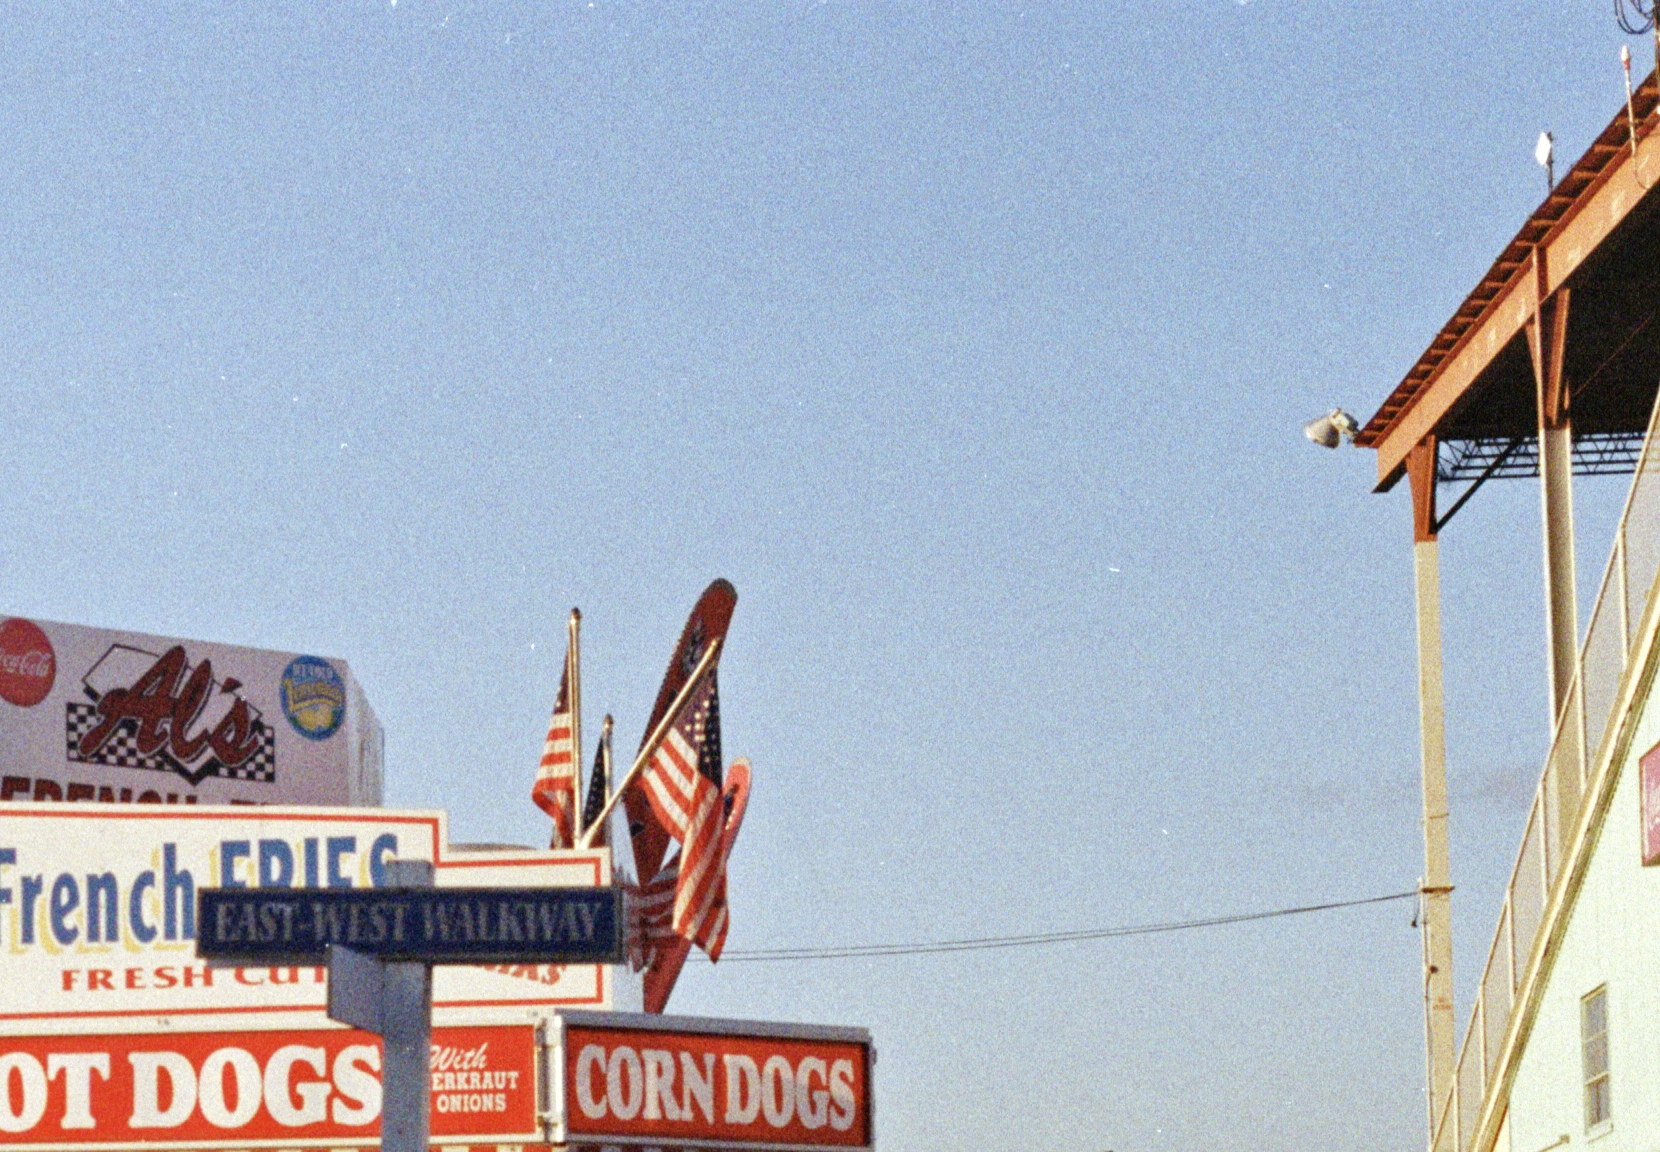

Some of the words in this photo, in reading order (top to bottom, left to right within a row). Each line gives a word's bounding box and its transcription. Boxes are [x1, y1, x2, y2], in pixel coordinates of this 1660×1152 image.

[216, 902, 409, 941] EAST-WEST
[423, 902, 602, 942] WALKWAY
[61, 964, 214, 991] FRESH
[128, 1043, 382, 1130] DOGS
[432, 1071, 520, 1091] ERKRAUT
[575, 1043, 717, 1127] CORN
[723, 1054, 857, 1131] DOGS
[436, 1094, 507, 1113] ONIONS
